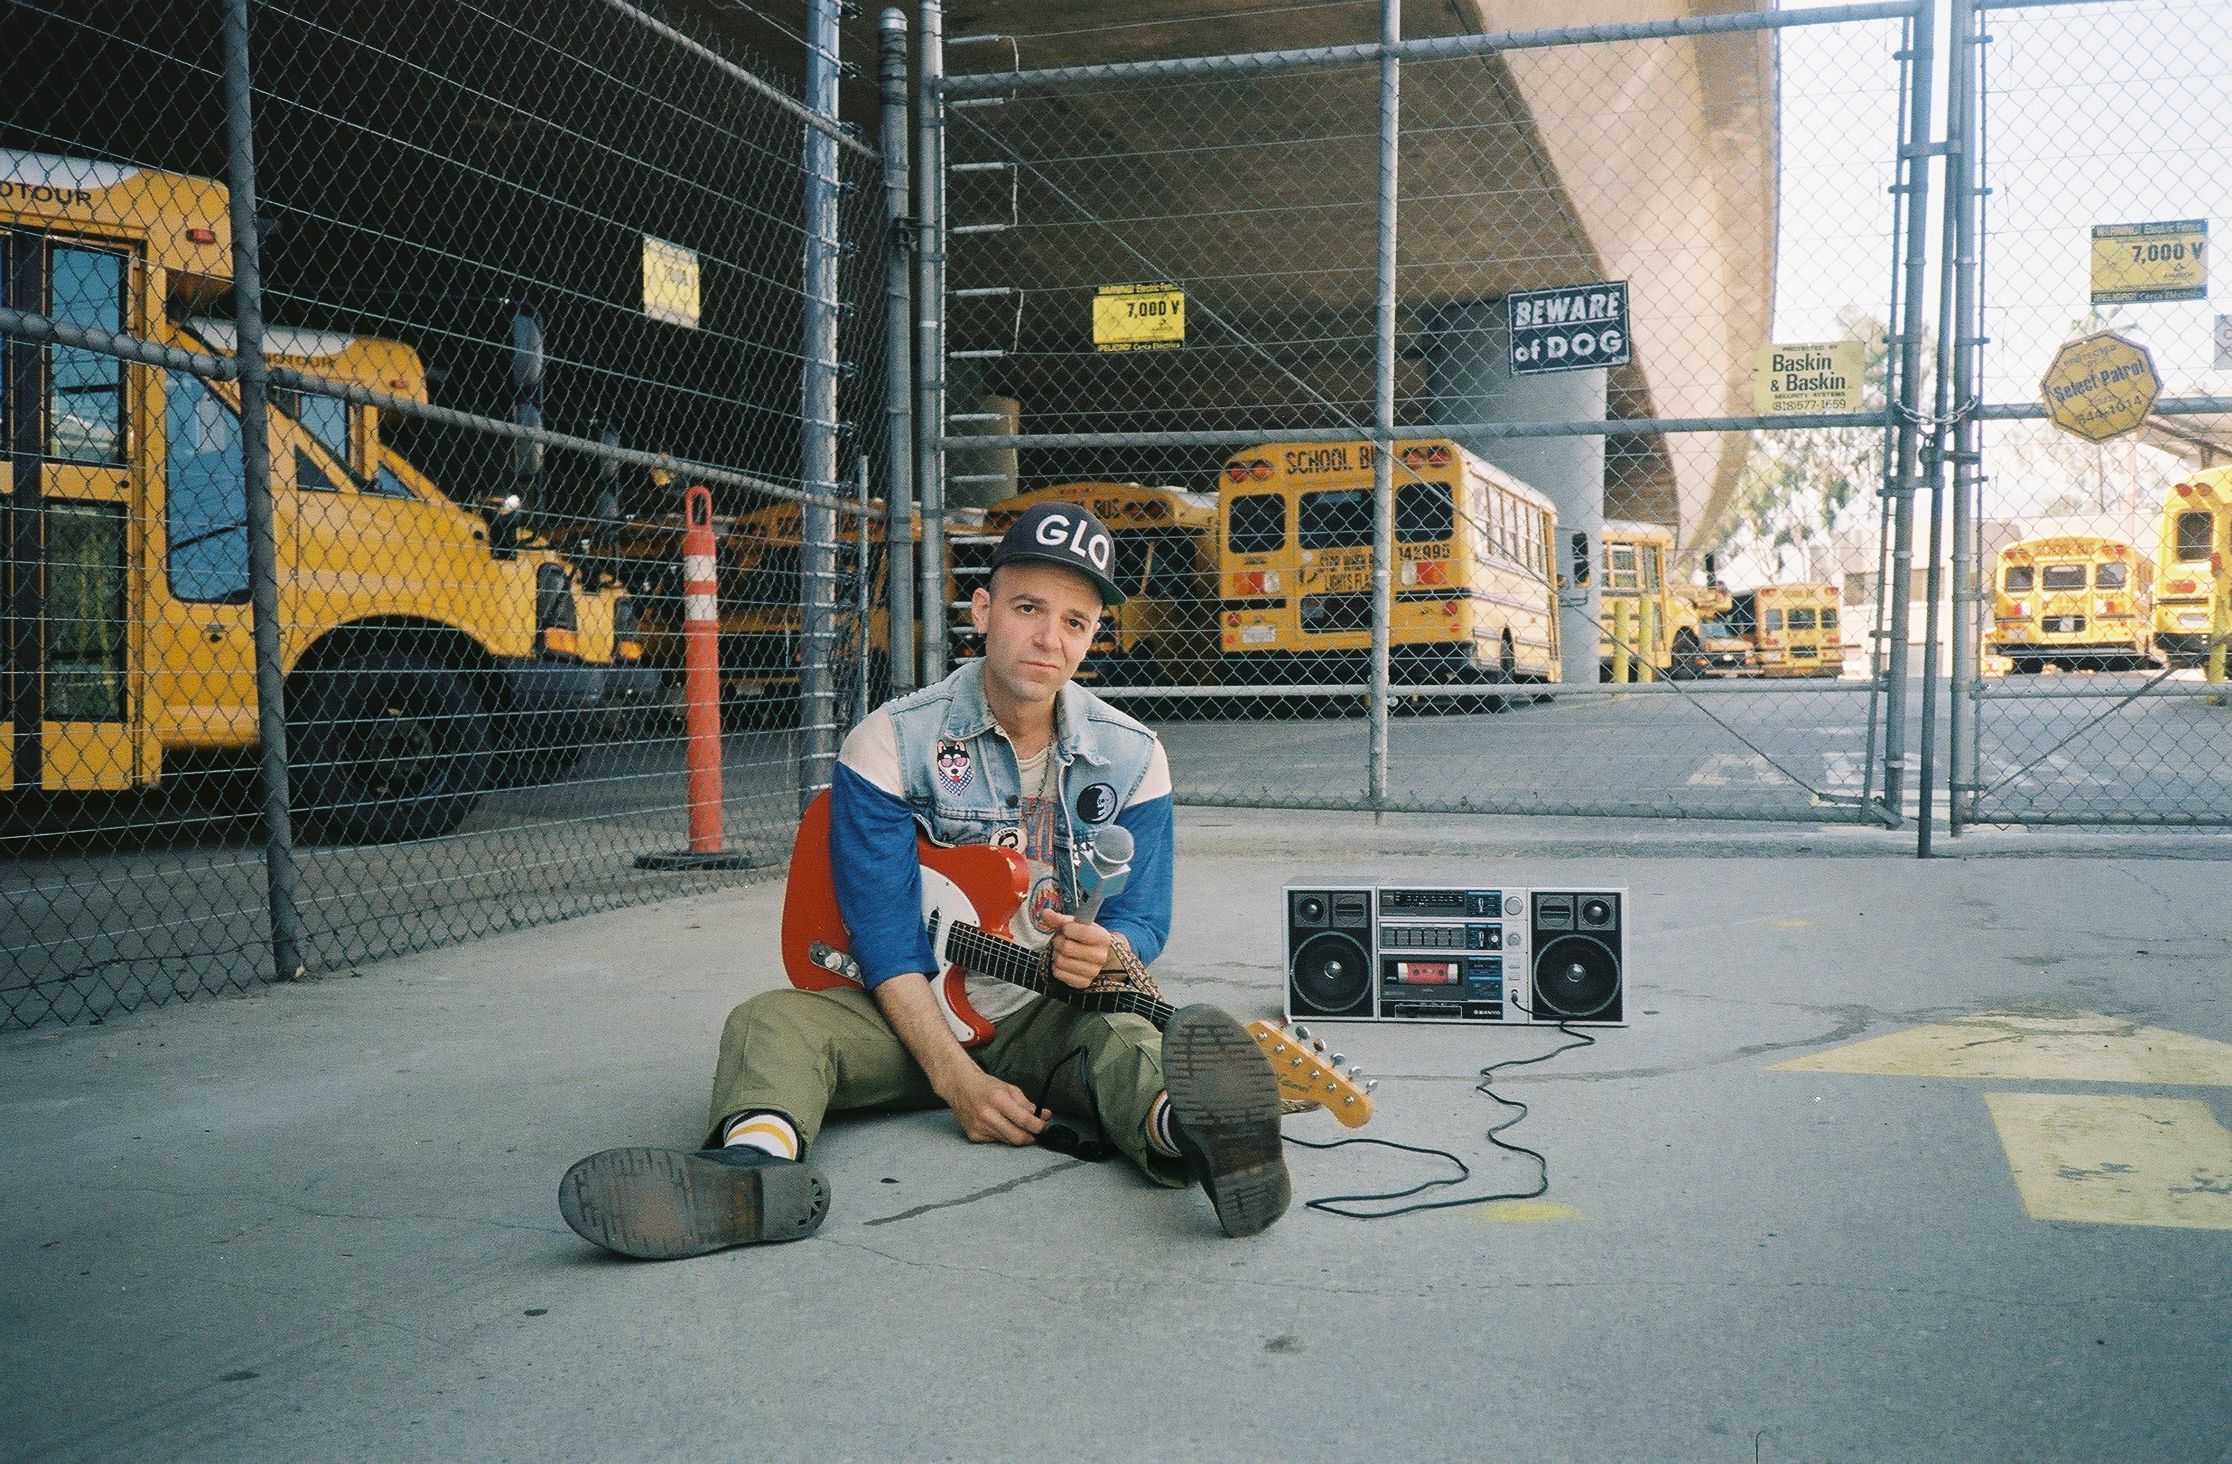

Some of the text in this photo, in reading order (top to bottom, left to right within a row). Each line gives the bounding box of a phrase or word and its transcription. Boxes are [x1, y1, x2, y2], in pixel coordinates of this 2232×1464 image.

[2132, 241, 2203, 264] 7,000 V
[1127, 300, 1180, 319] 7,000 V
[1515, 291, 1620, 327] BEWARE
[1515, 330, 1623, 361] of DOG
[1773, 353, 1832, 373] Baskin
[1770, 371, 1846, 392] & Baskin
[2053, 359, 2144, 402] Select Patrol
[1285, 448, 1353, 475] SCHOOL
